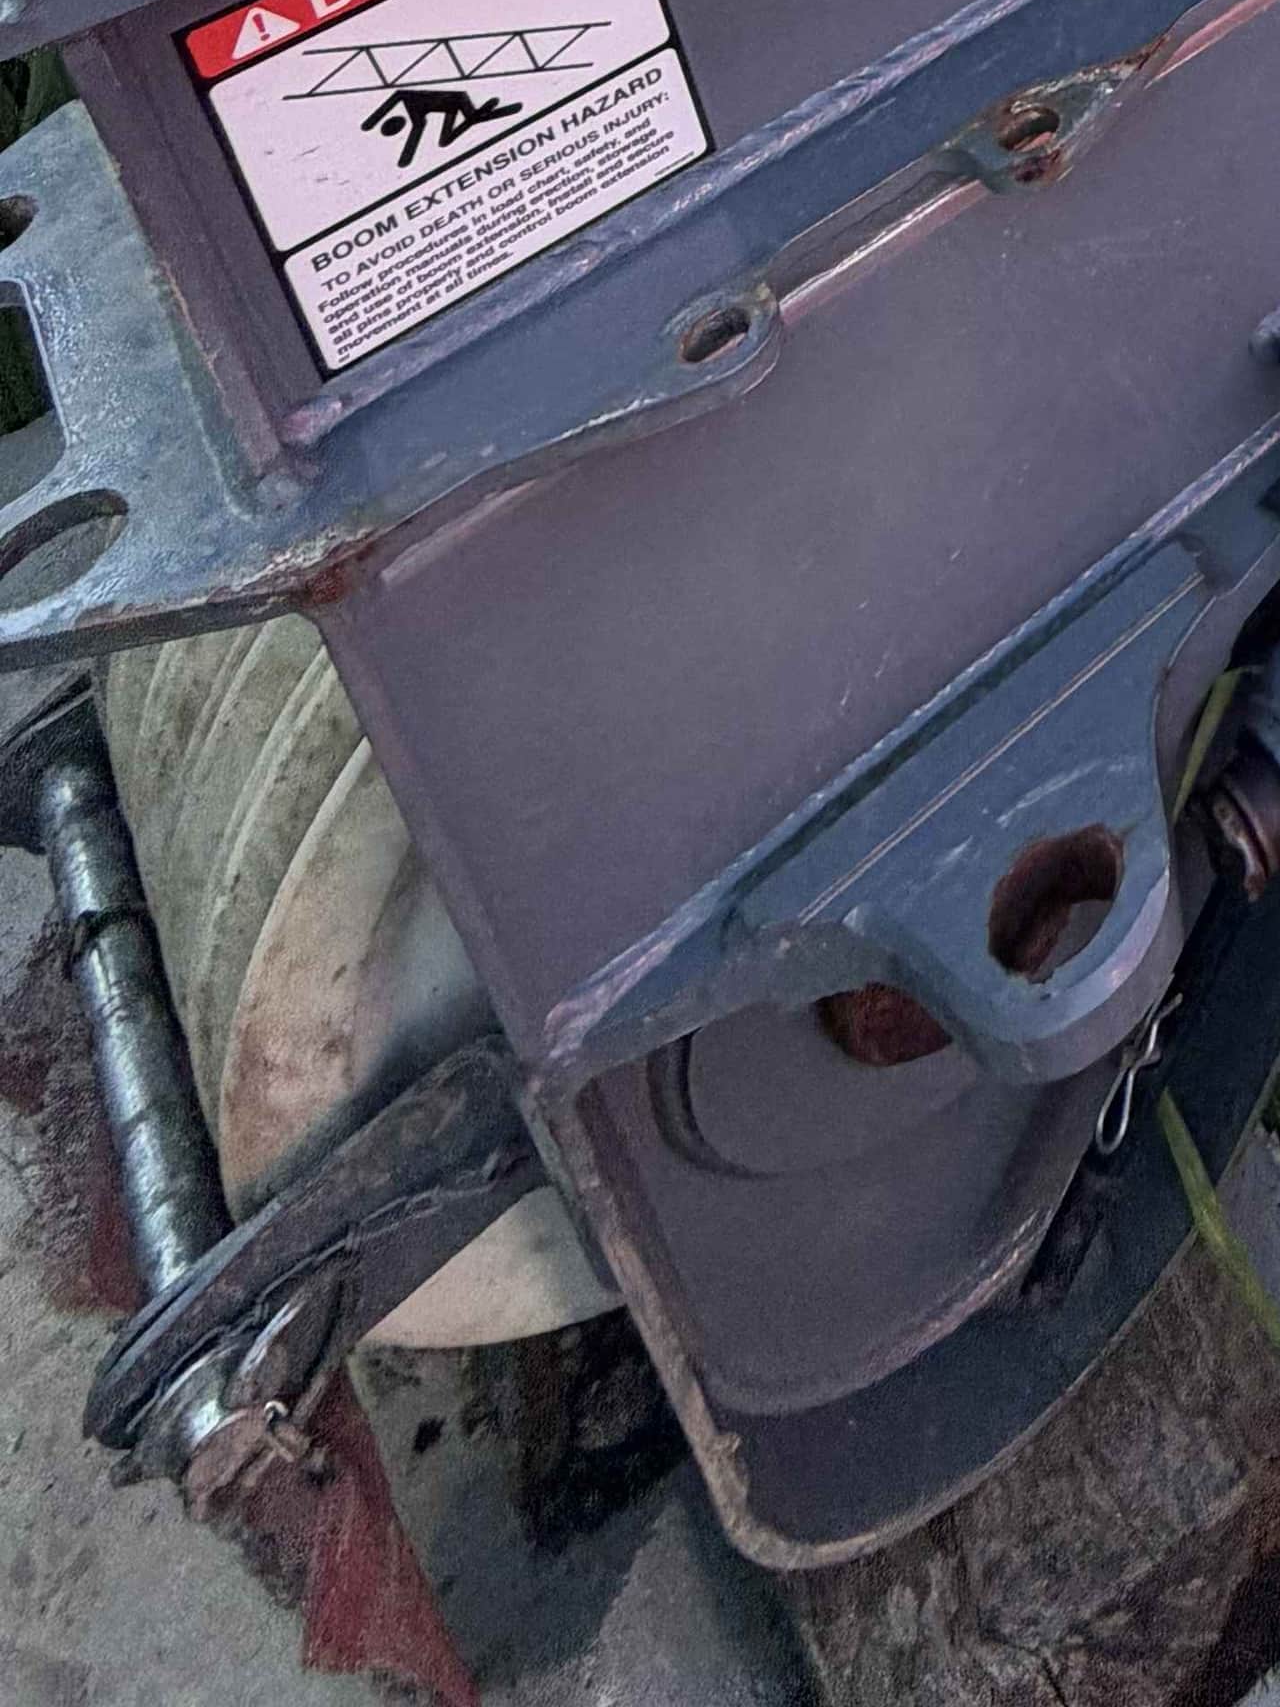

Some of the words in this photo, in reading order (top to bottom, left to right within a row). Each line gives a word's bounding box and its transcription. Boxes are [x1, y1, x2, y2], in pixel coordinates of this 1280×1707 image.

[310, 213, 399, 273] BOOM
[403, 126, 556, 221] EXTENSION
[560, 68, 662, 133] HAZARD
[317, 278, 373, 313] Follow
[377, 224, 469, 282] procedures
[471, 213, 487, 226] in
[490, 189, 524, 215] load
[527, 167, 570, 194] chart,
[574, 138, 621, 168] safety,
[624, 117, 651, 139] and
[321, 271, 351, 292] TO
[356, 234, 415, 276] AVOID
[419, 195, 484, 239] DEATH
[487, 178, 516, 199] OR
[519, 130, 600, 182] SERIOUS
[603, 92, 670, 135] INJURY:
